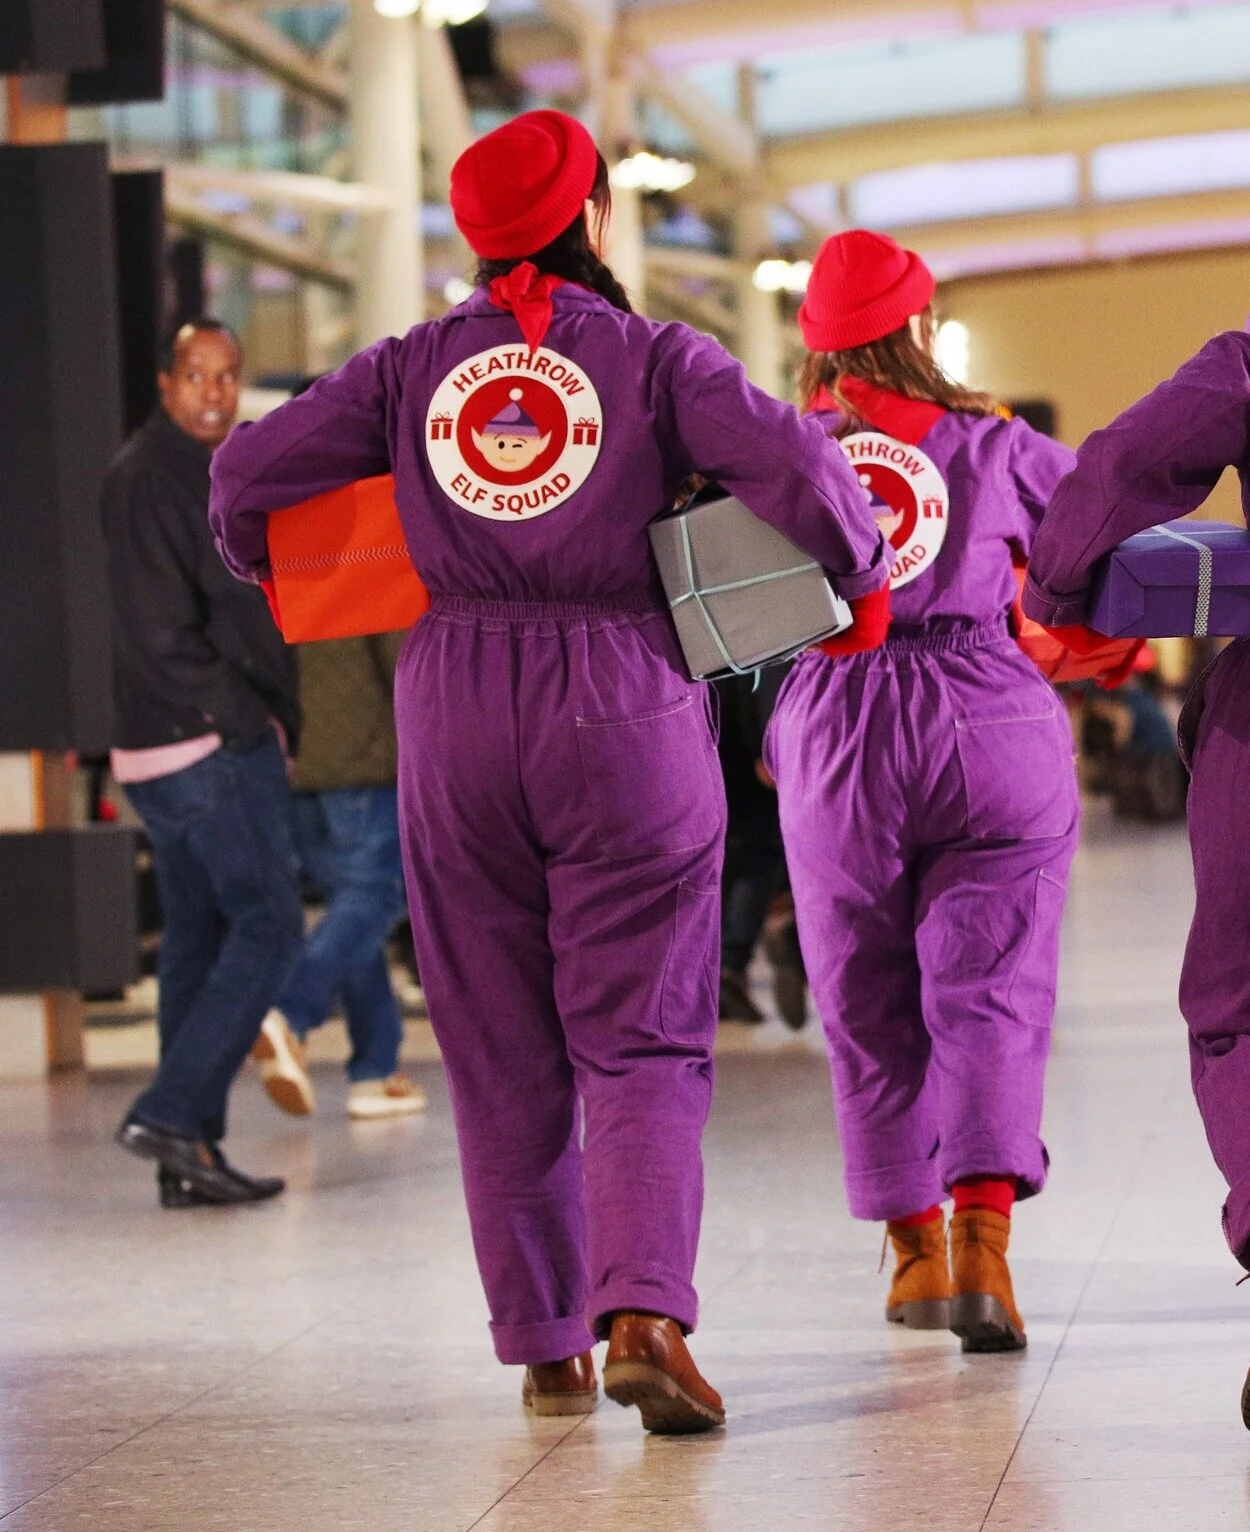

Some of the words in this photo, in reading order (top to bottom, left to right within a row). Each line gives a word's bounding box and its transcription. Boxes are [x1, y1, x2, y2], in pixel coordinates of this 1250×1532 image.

[452, 352, 585, 397] HEATHROW
[846, 441, 925, 476] THROW
[450, 473, 488, 504] ELF
[492, 472, 571, 515] SQUAD
[890, 544, 926, 579] UAD
